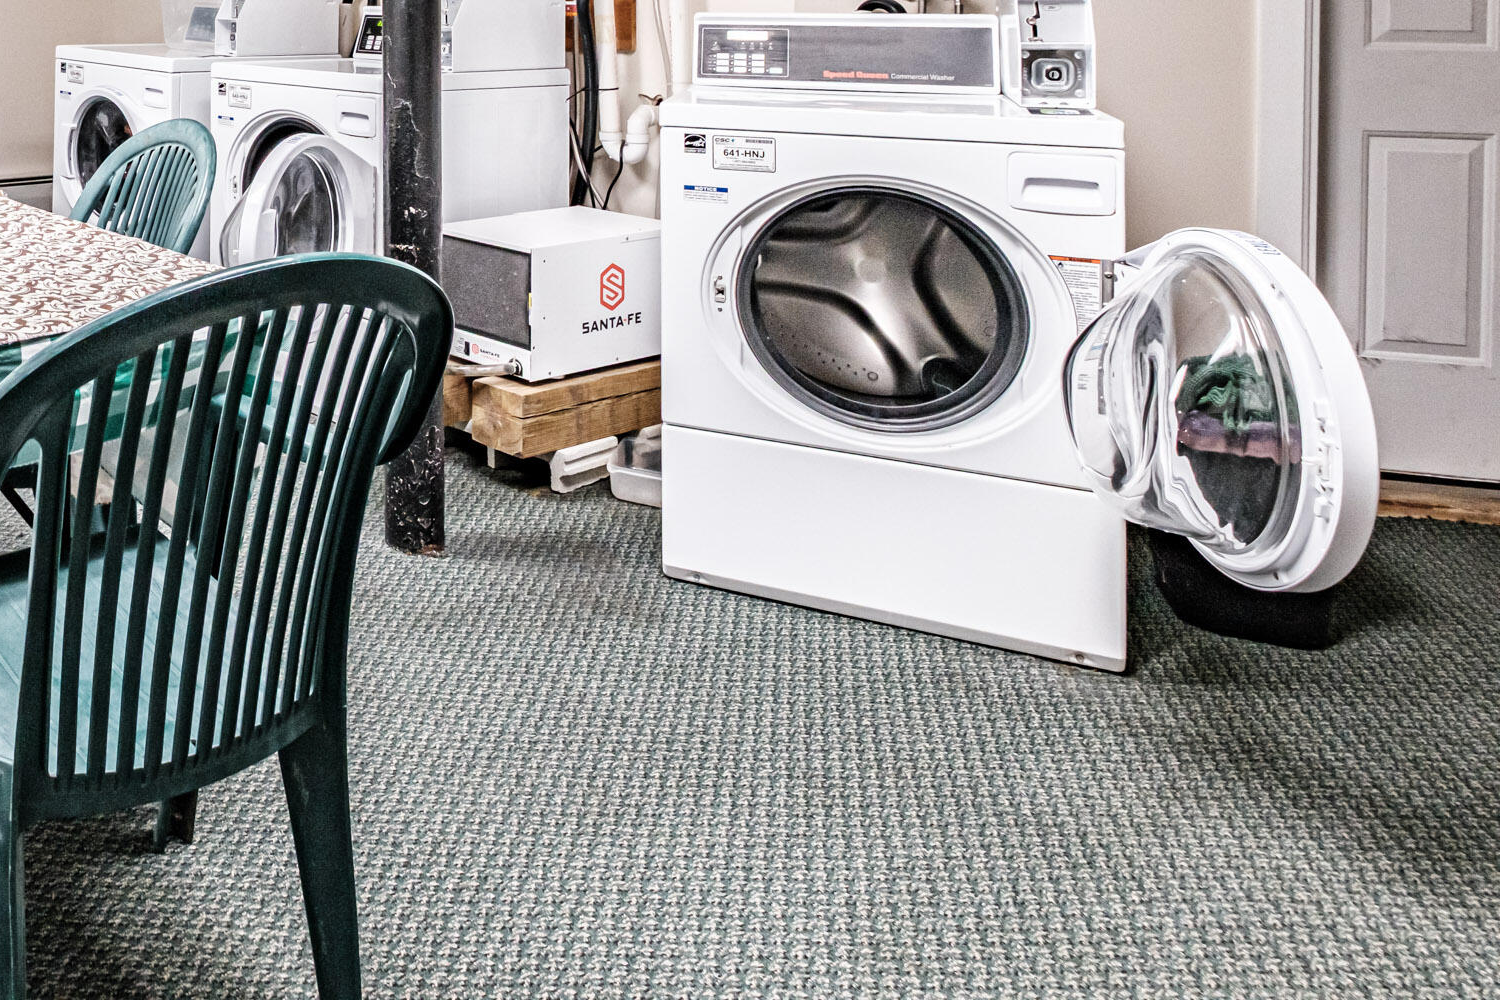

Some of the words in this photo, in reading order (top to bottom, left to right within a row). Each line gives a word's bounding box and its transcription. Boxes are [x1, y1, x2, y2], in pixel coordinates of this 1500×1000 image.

[823, 70, 855, 79] Speed
[856, 71, 889, 80] Queen
[723, 149, 765, 158] 641-HNJ
